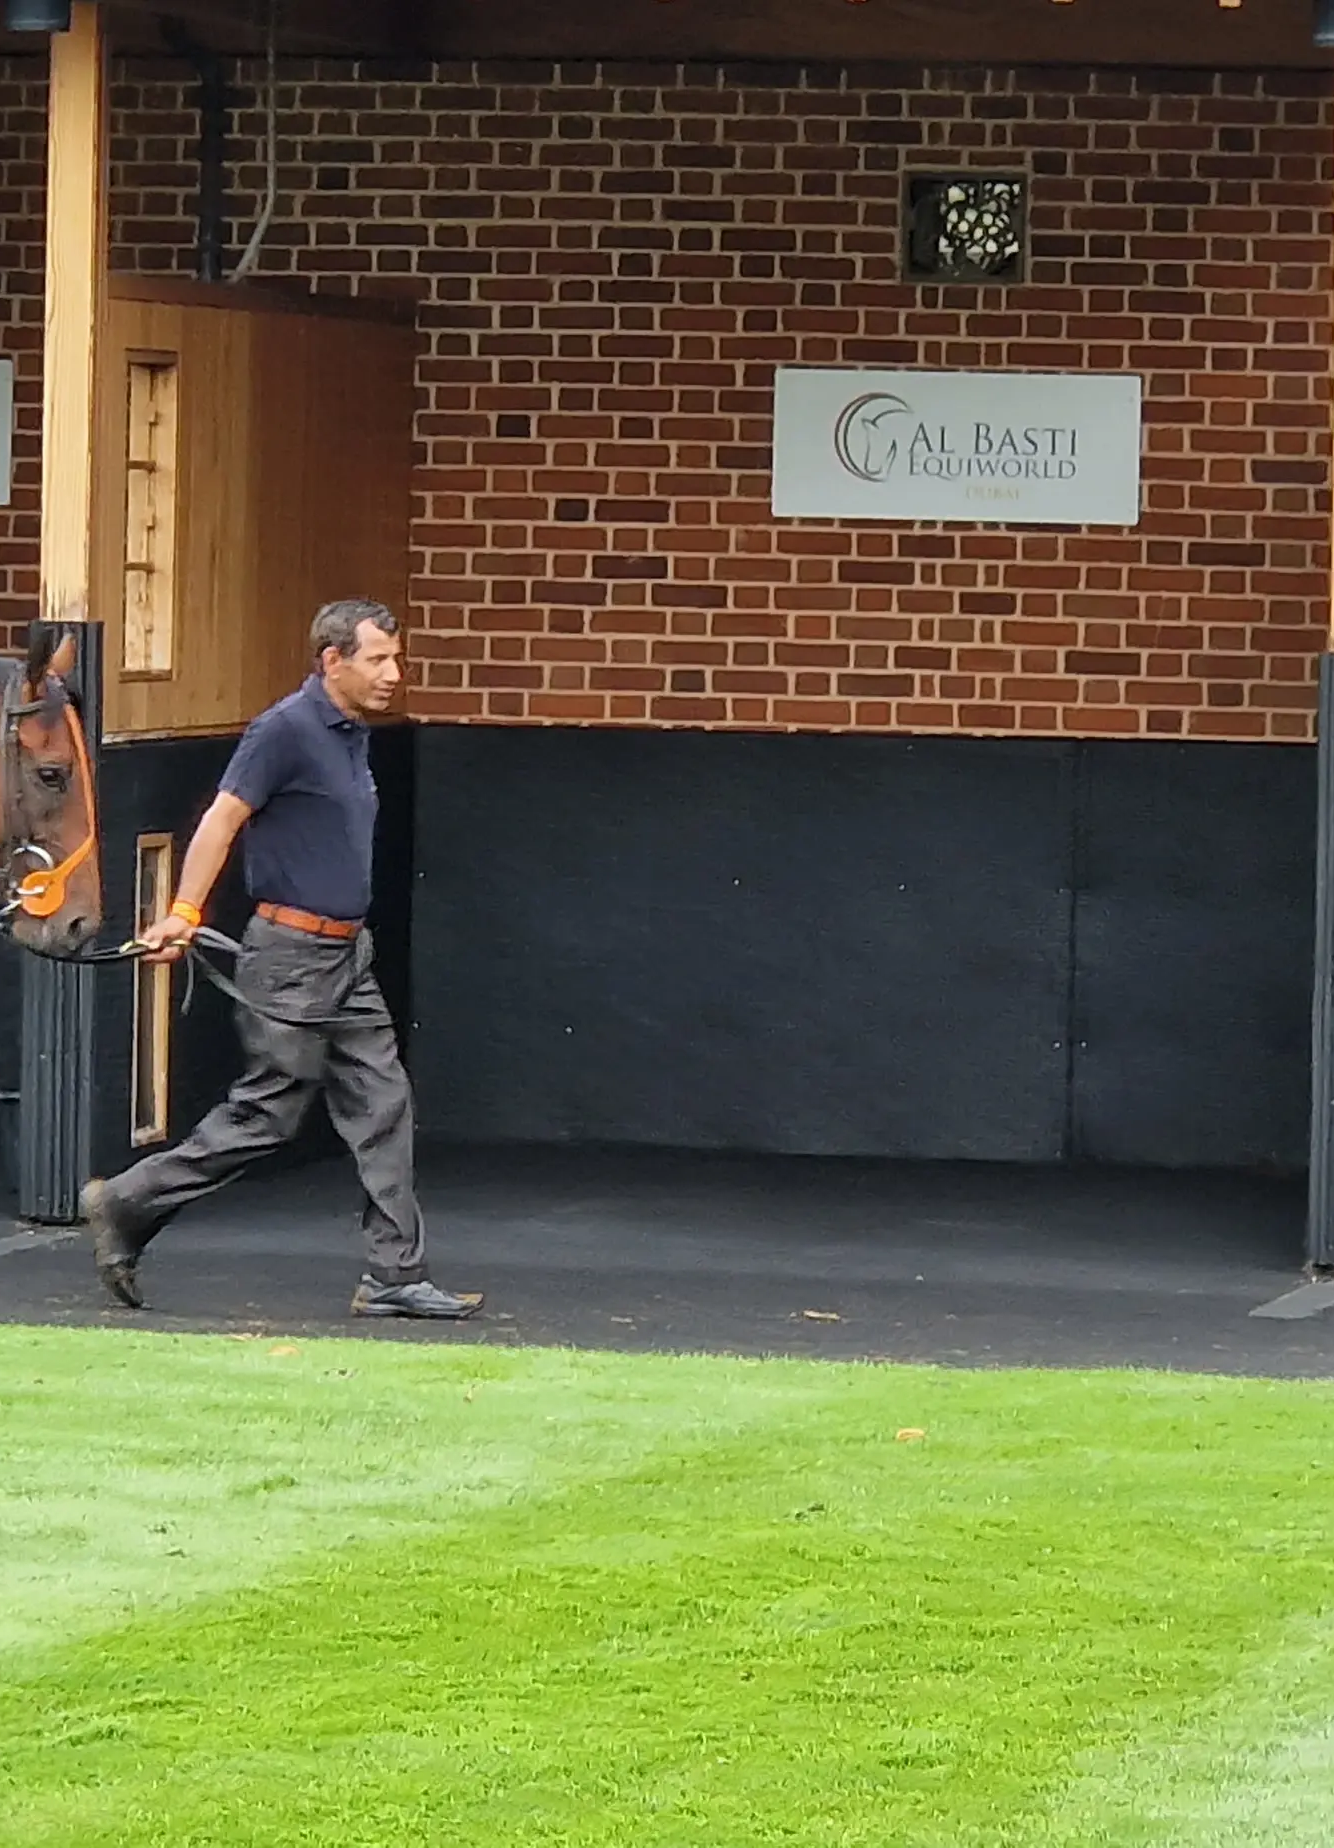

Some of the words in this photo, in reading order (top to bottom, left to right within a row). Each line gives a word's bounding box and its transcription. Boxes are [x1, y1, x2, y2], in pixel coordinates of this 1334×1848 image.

[908, 422, 955, 455] AL
[974, 422, 1078, 457] BASTI
[908, 455, 1077, 481] EQUIWORLD
